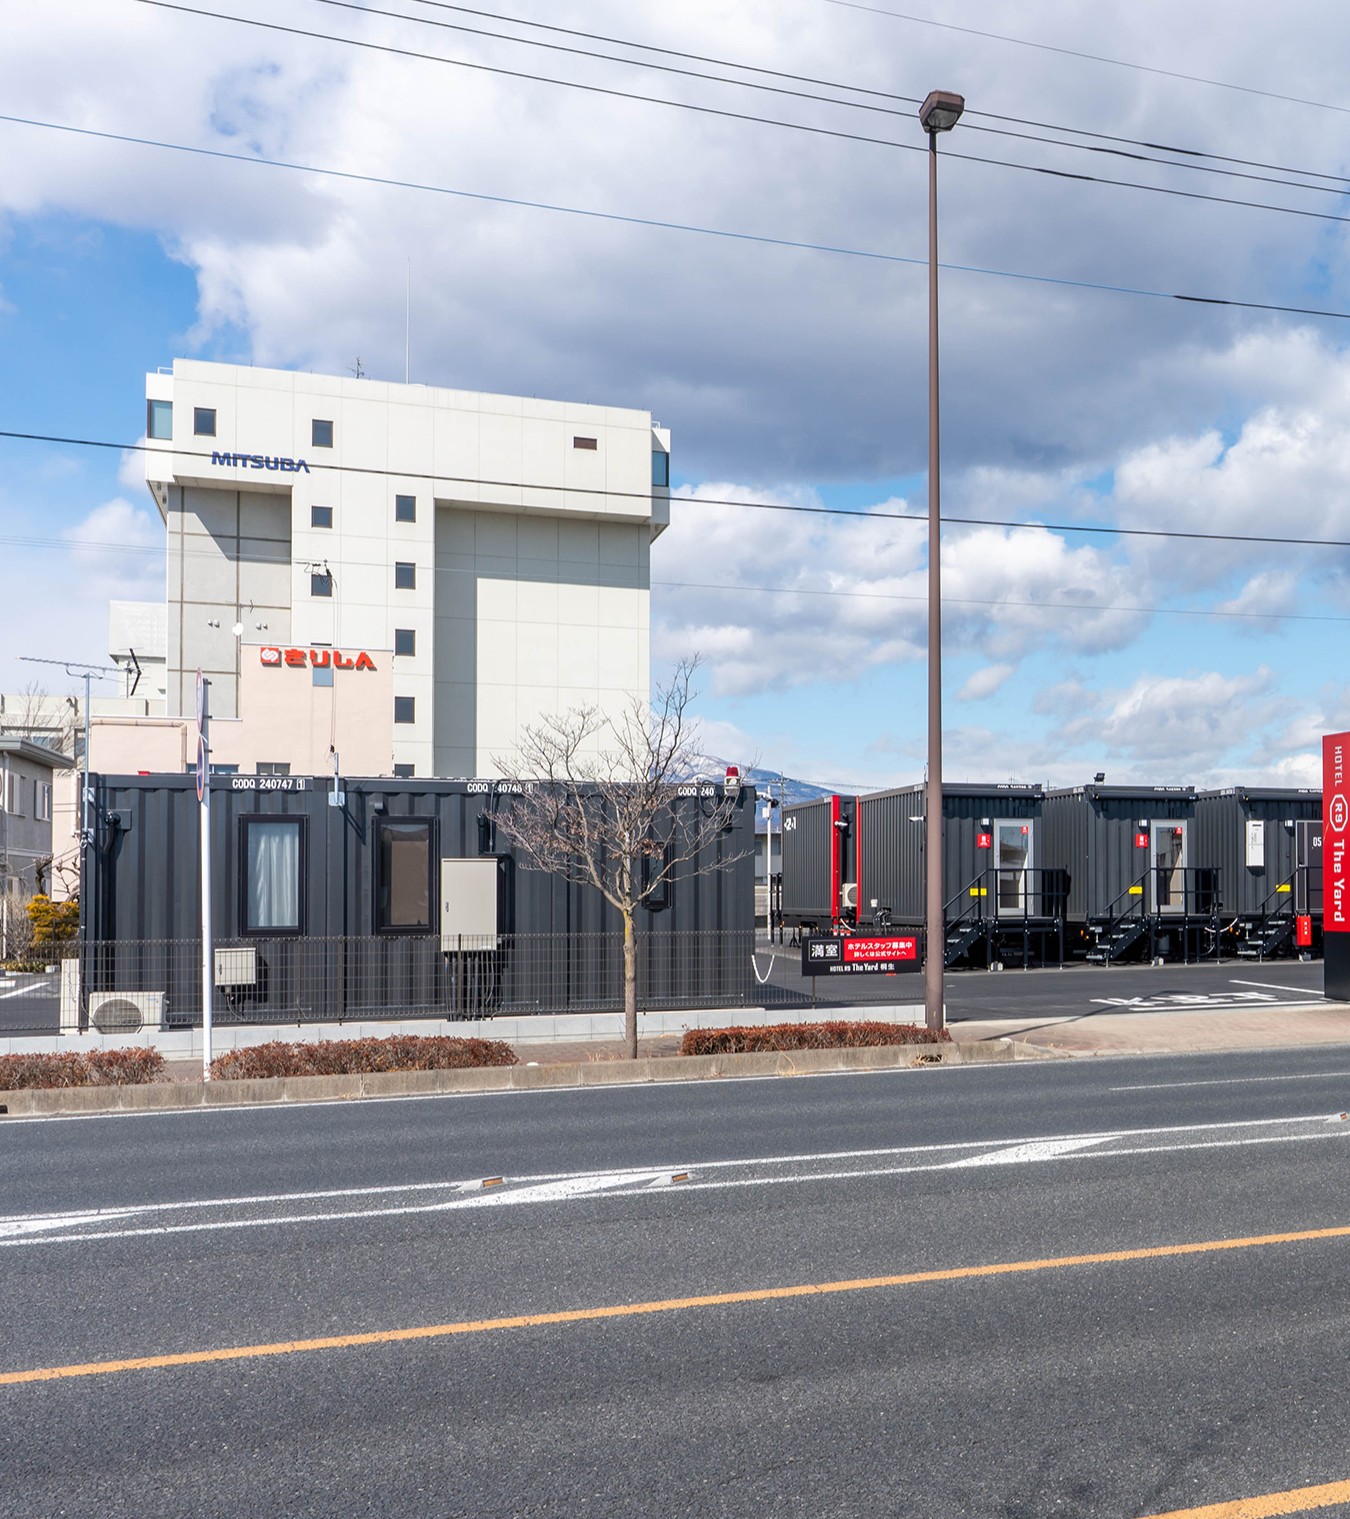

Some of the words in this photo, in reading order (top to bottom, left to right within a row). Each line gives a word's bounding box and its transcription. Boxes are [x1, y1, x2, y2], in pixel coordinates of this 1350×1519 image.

[211, 451, 310, 473] MITSUBA
[284, 649, 376, 668] きりしん
[1334, 745, 1342, 787] HOTEL
[260, 779, 293, 789] 240747
[1335, 803, 1342, 822] R9
[1313, 836, 1322, 847] 05
[1333, 839, 1345, 873] The
[1333, 879, 1345, 922] Yard
[811, 943, 838, 957] 満室
[848, 942, 912, 950] ホテルスタッフ募集中
[852, 963, 863, 971] The
[864, 962, 879, 971] Yard
